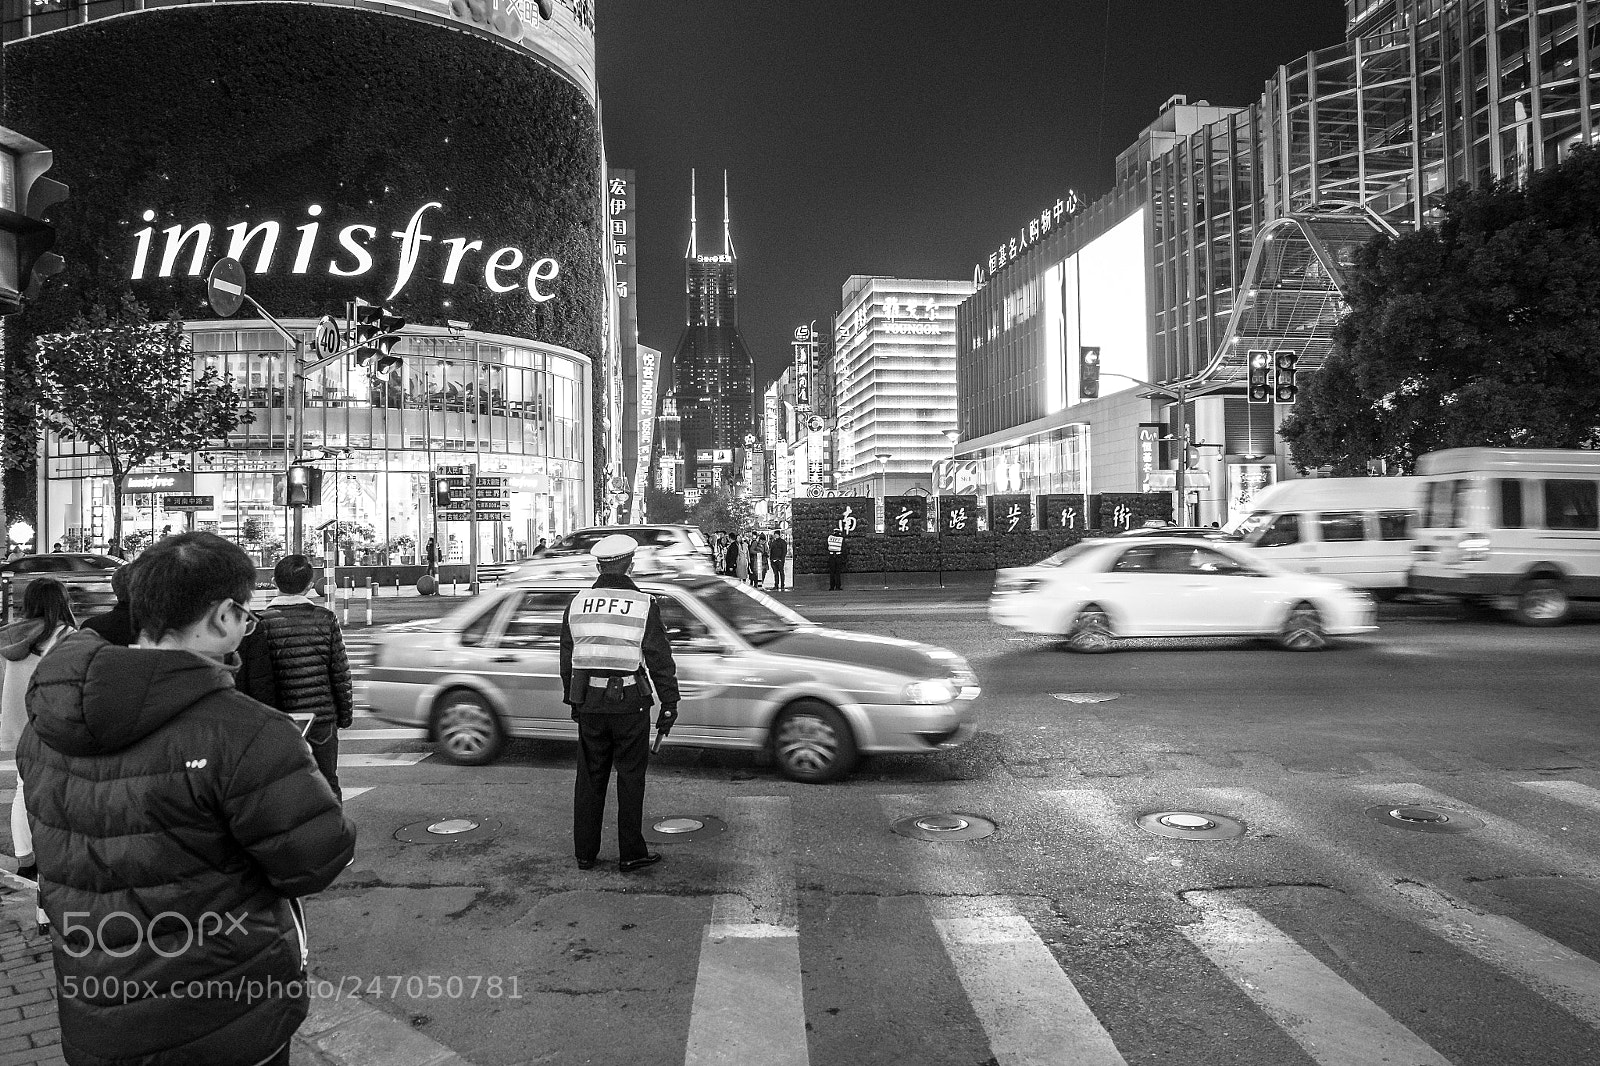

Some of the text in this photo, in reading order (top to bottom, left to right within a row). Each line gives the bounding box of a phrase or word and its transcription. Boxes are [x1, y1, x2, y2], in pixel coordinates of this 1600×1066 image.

[989, 189, 1078, 275] 恒基名人购物中心
[130, 202, 560, 302] innisfree
[320, 327, 335, 353] 40
[882, 324, 941, 335] YOUNGOR
[641, 421, 652, 444] OSAIC
[447, 466, 471, 475] 人民广
[838, 503, 1132, 535] 南京路步行街
[582, 598, 634, 615] HPFJ
